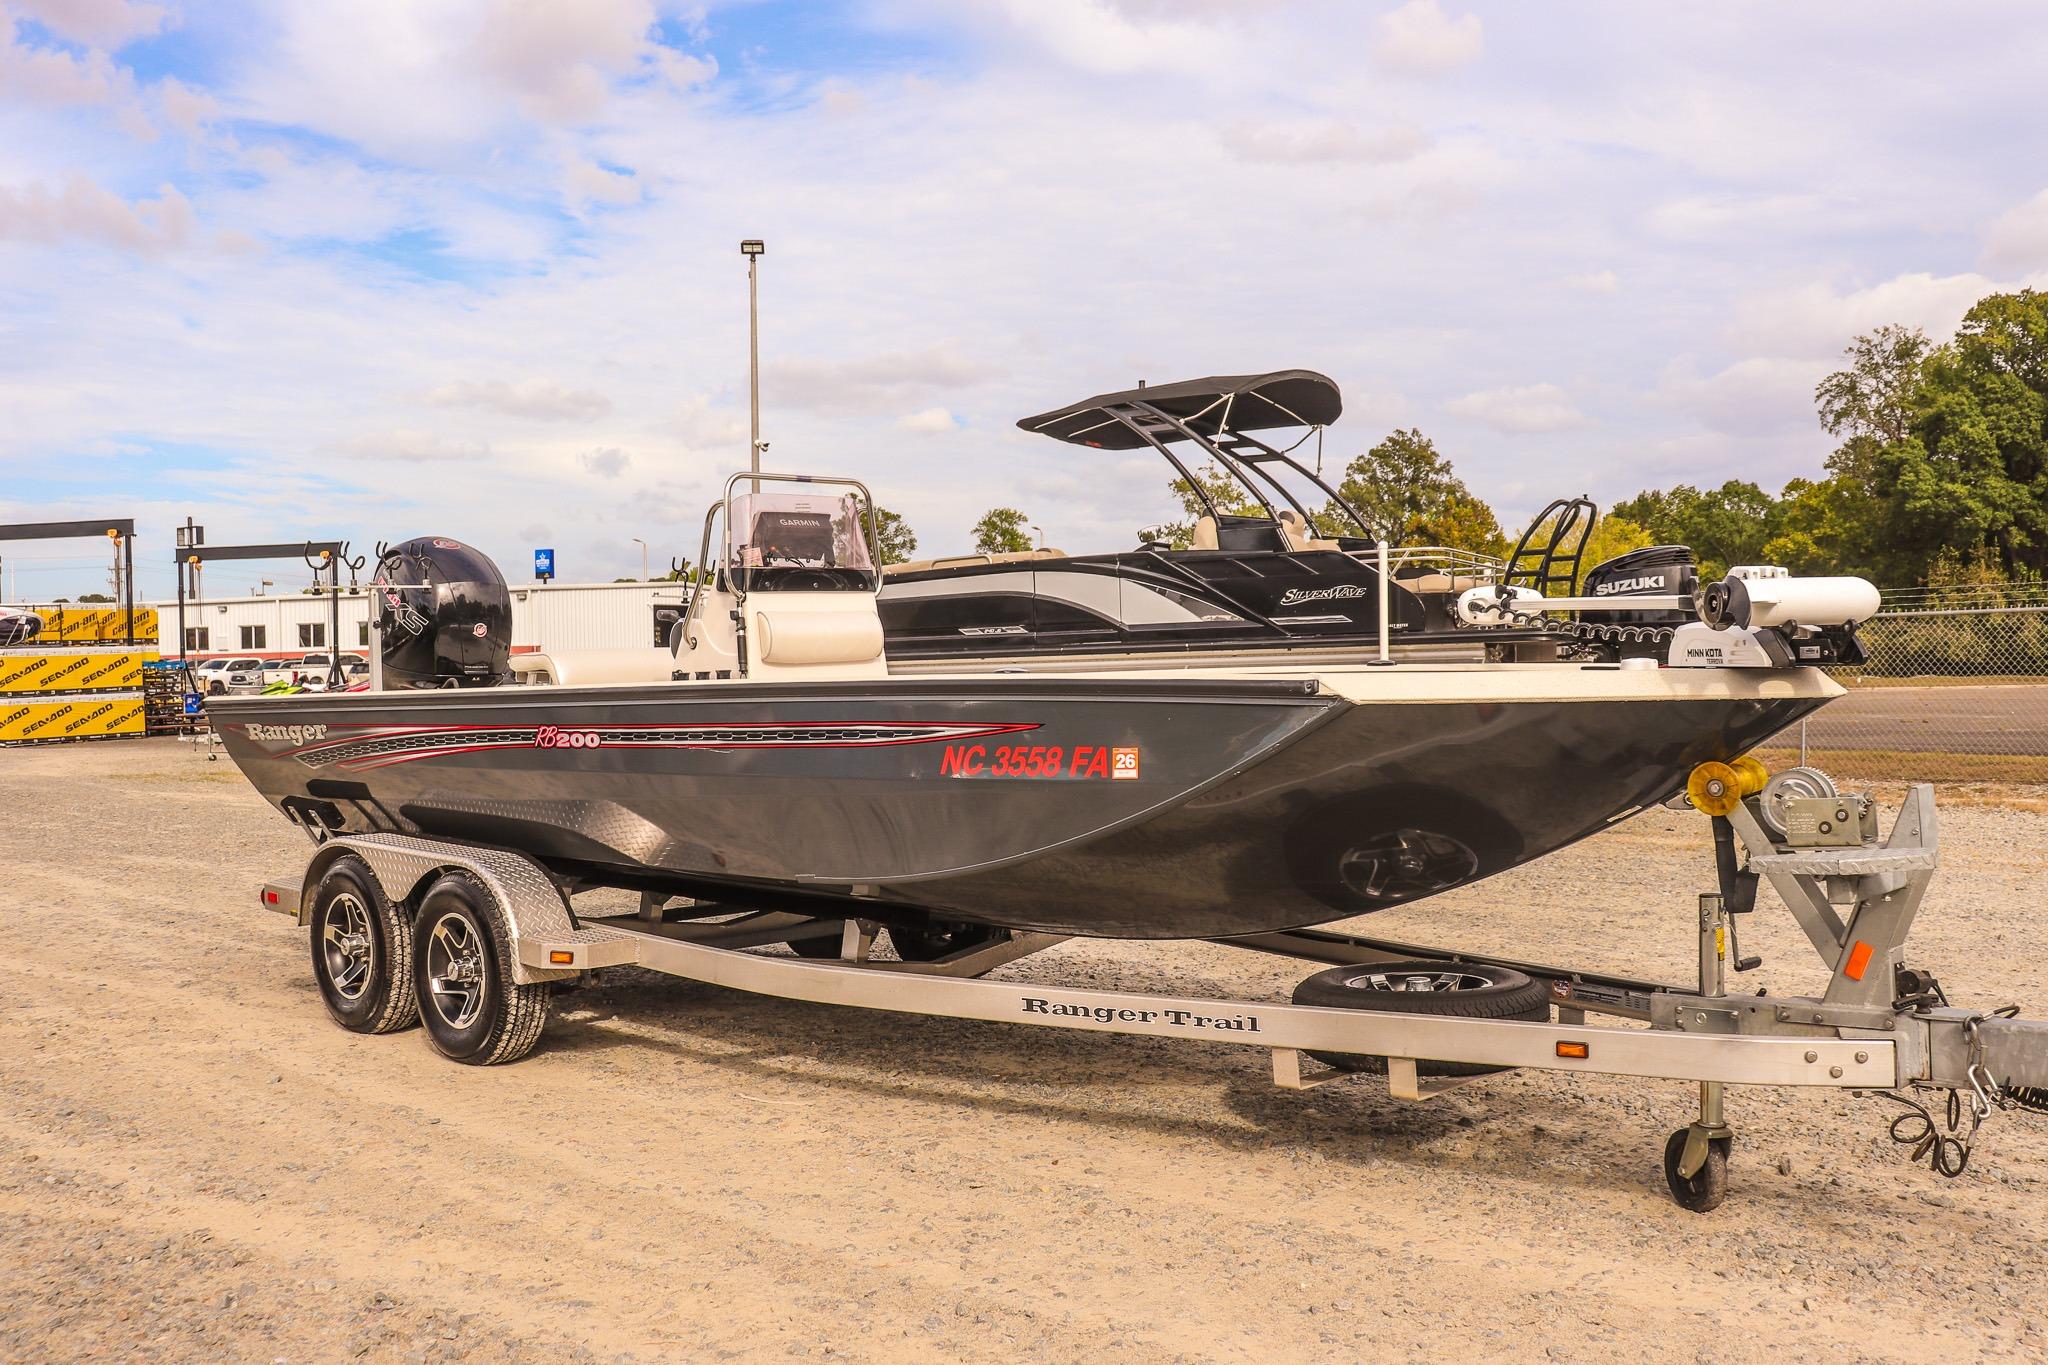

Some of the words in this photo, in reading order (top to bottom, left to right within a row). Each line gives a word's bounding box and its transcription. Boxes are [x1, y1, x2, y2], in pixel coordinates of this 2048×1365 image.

[780, 518, 821, 527] GARMIN
[1596, 575, 1665, 596] SUZUKI
[1687, 648, 1704, 657] MINN
[1705, 648, 1723, 657] KOTA
[245, 723, 327, 746] Ranger
[940, 745, 986, 776] NC
[991, 746, 1064, 777] 3558
[1068, 746, 1108, 778] FA
[1115, 753, 1136, 769] 26
[1021, 997, 1158, 1023] Ranger
[1164, 1010, 1262, 1033] Trail
